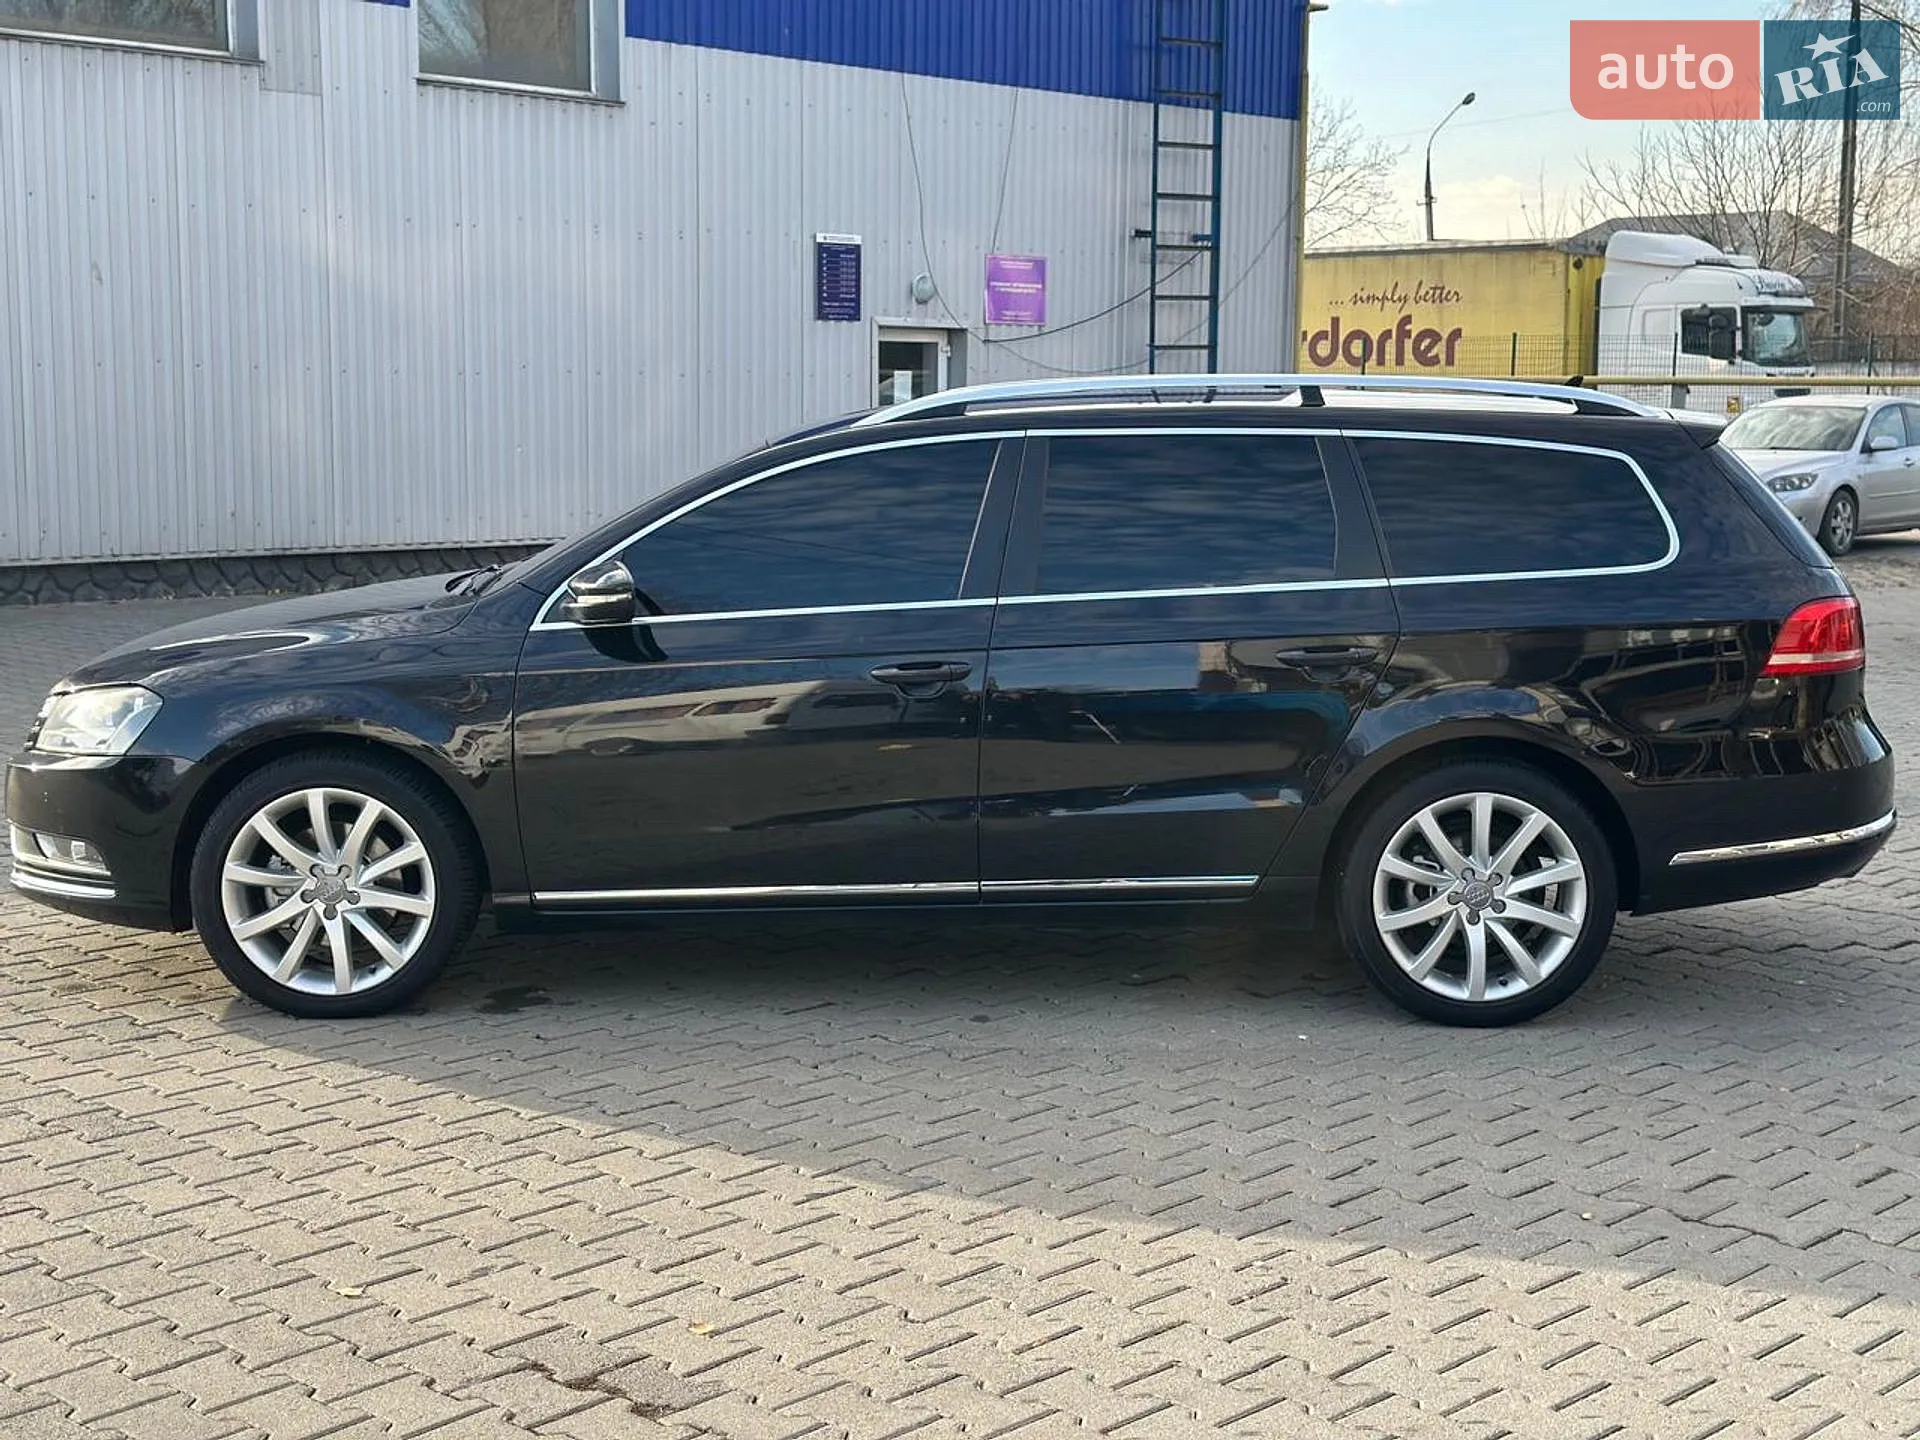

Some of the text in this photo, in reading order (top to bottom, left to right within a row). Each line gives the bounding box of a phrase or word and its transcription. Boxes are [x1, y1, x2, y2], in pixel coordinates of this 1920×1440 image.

[1350, 280, 1409, 313] simply
[1414, 279, 1463, 304] better
[1301, 314, 1462, 367] dorfer
